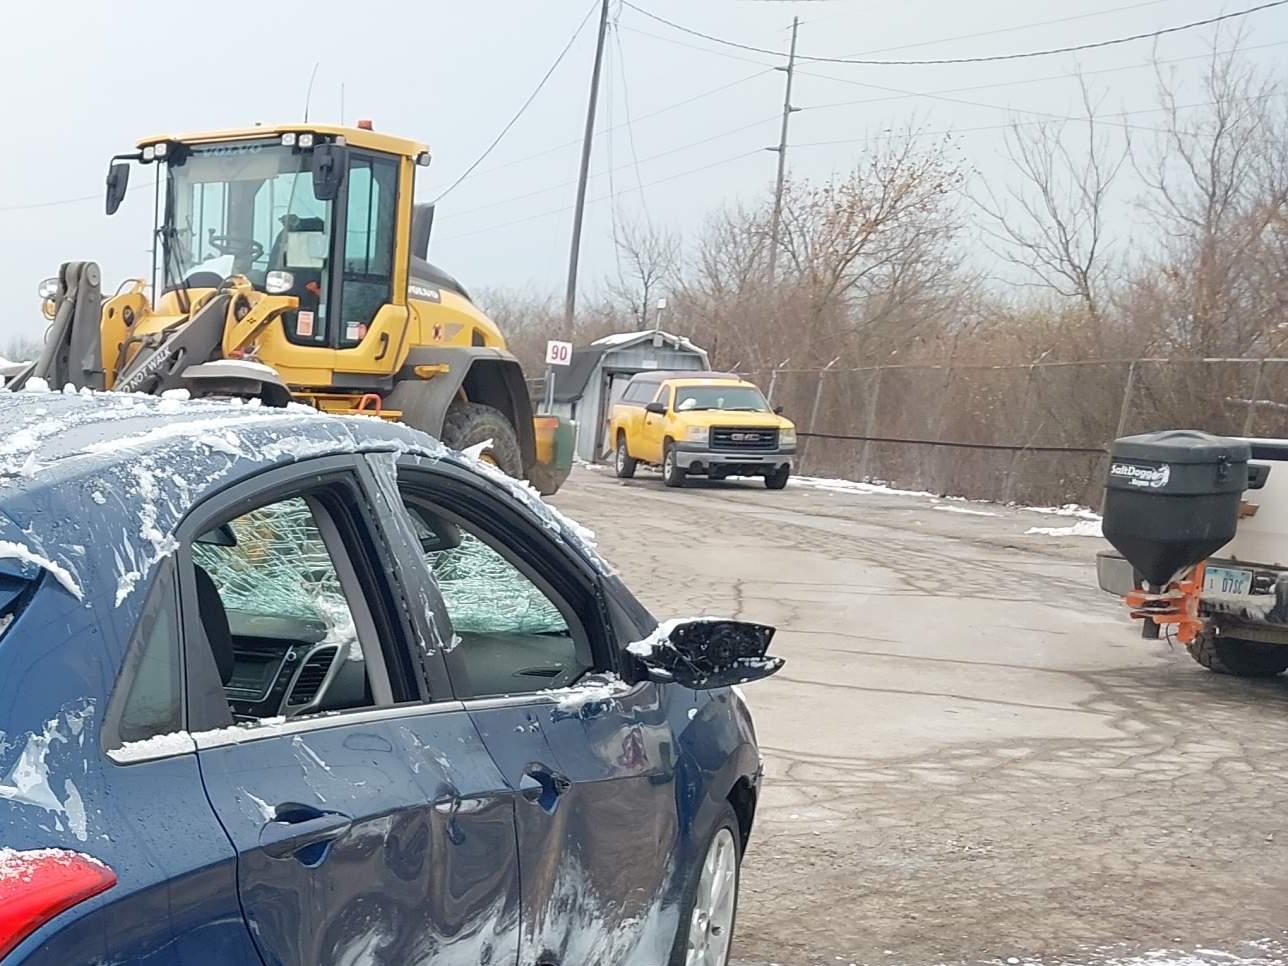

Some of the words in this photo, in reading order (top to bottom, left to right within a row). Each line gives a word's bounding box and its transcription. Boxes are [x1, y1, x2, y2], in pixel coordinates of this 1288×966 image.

[129, 366, 148, 389] NOT
[147, 346, 172, 371] WALK
[551, 344, 568, 361] 90
